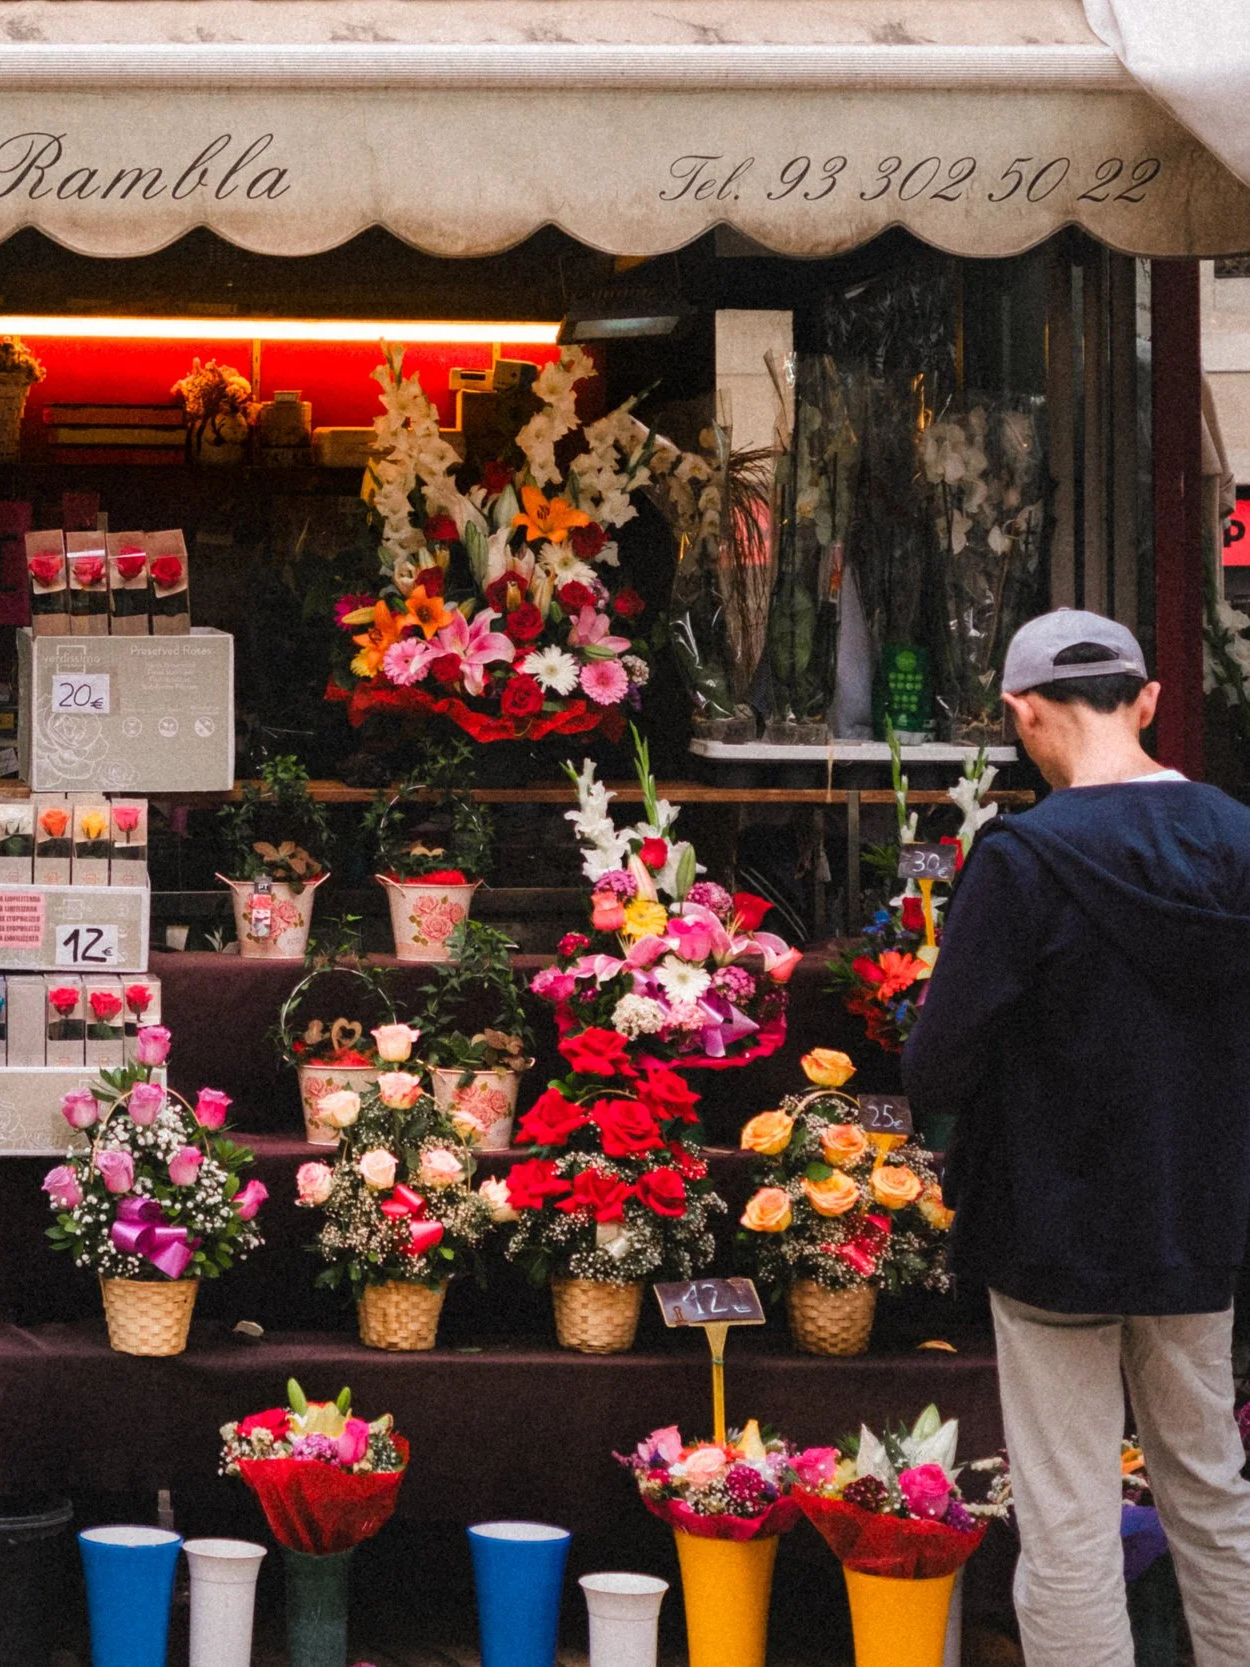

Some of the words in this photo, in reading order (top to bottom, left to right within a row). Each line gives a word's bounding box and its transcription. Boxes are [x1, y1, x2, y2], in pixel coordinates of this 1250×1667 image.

[659, 154, 755, 202] Tel.
[766, 155, 849, 202] 93
[859, 155, 978, 202] 302
[987, 156, 1072, 203] 50
[1076, 157, 1163, 203] 22
[43, 651, 101, 664] verdissimo
[130, 645, 180, 656] Preserved
[58, 682, 104, 710] 20€
[912, 850, 949, 879] 30€
[63, 928, 113, 963] 12€
[867, 1104, 904, 1130] 25€
[681, 1283, 753, 1316] 12€
